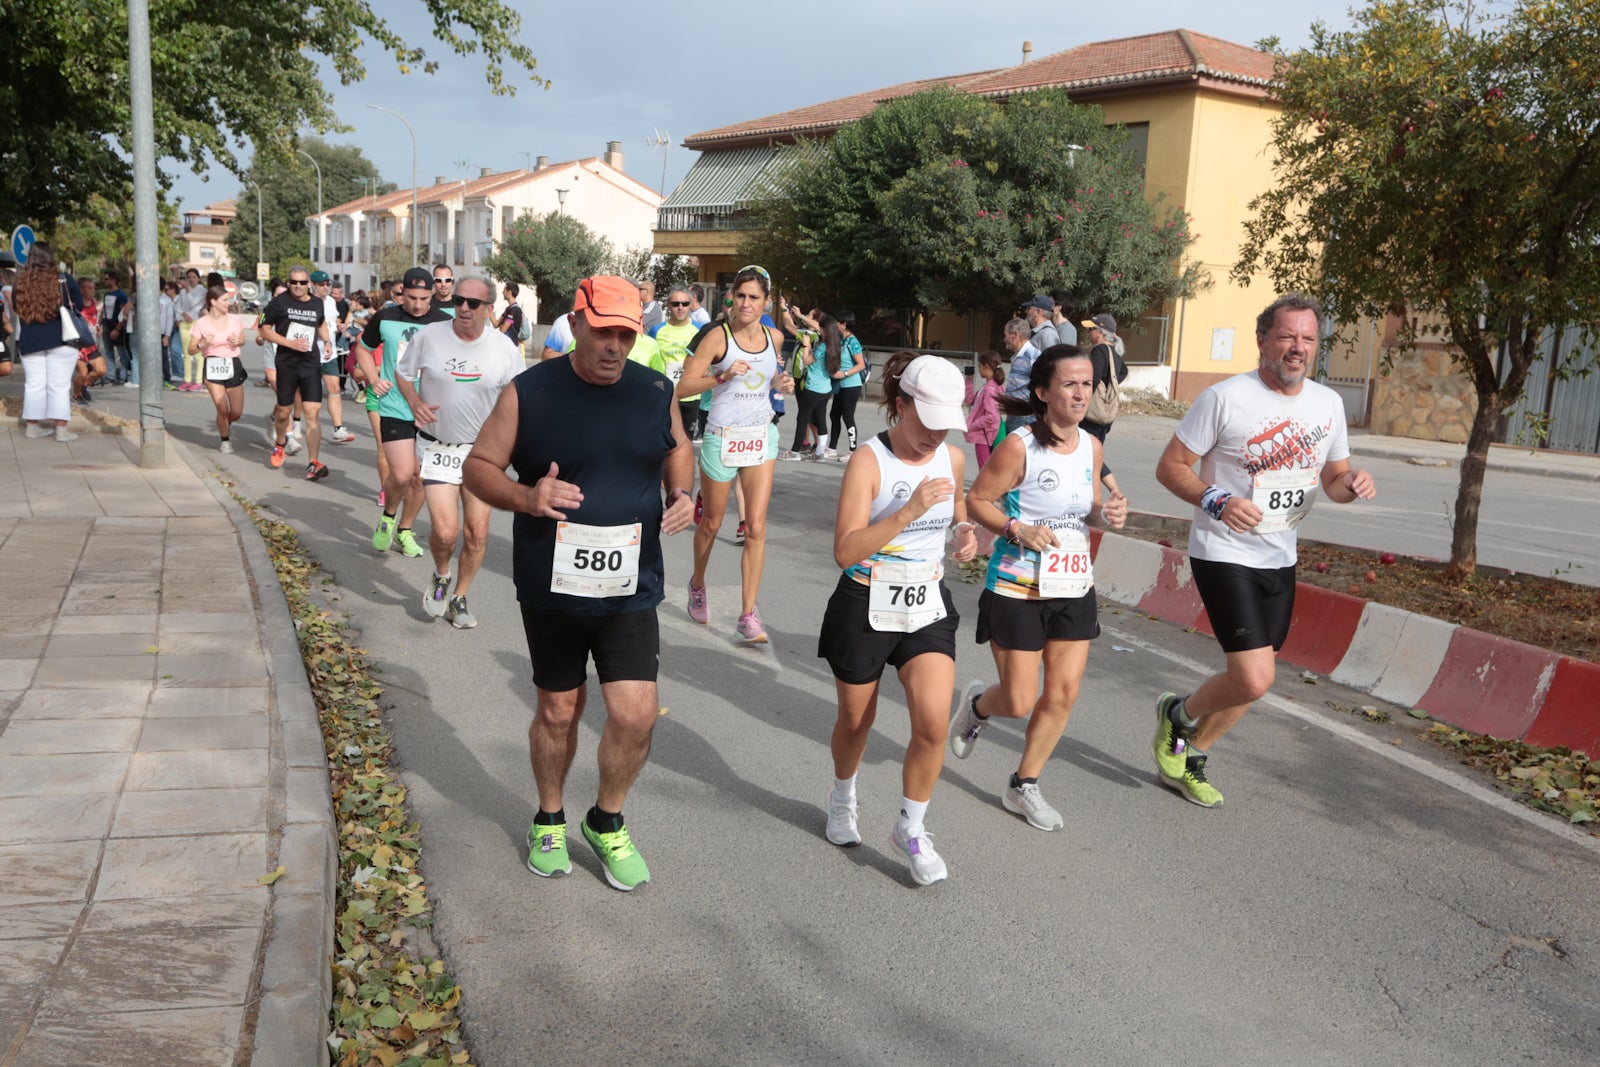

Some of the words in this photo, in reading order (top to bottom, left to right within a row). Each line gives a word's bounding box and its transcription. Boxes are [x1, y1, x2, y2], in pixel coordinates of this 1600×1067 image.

[287, 308, 317, 317] GALSER
[210, 366, 230, 374] 3107
[728, 439, 763, 453] 2049
[848, 426, 856, 448] FILA
[1246, 444, 1299, 475] ANIMAL
[1298, 425, 1328, 450] TRAIL
[432, 453, 461, 469] 309
[1269, 489, 1305, 510] 833
[573, 548, 623, 572] 580
[1048, 553, 1088, 574] 2183
[889, 584, 927, 608] 768
